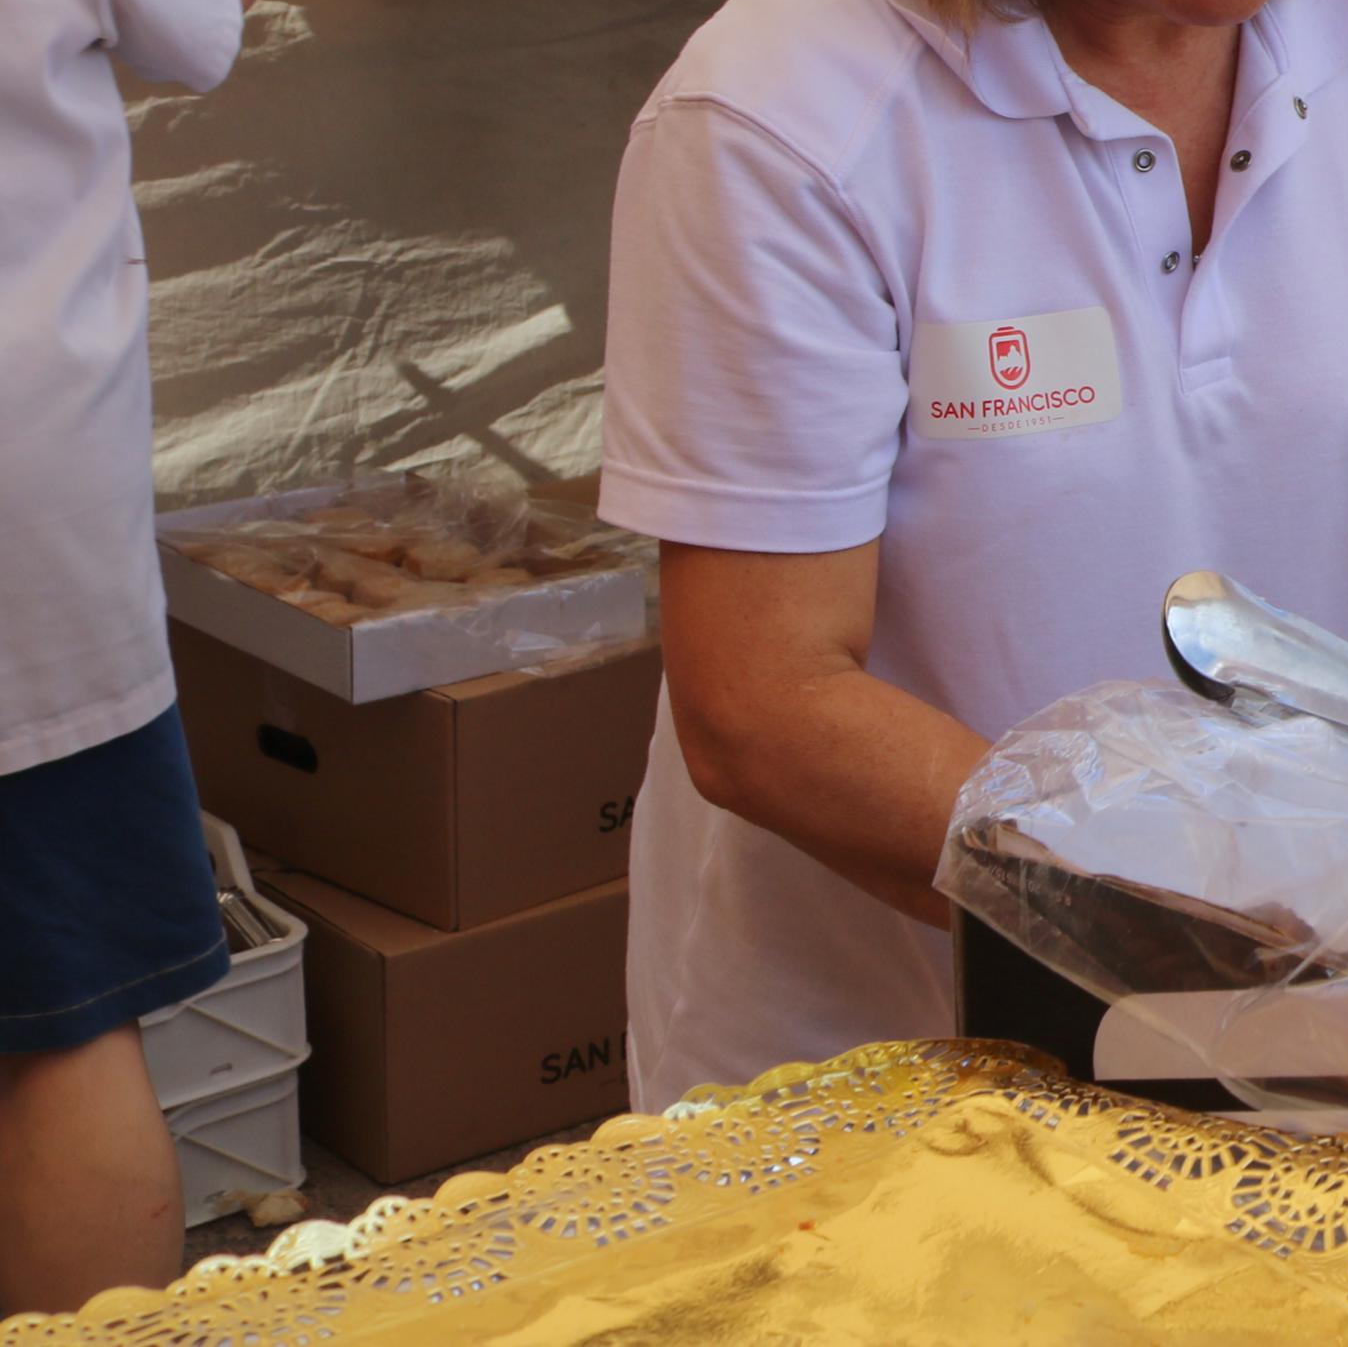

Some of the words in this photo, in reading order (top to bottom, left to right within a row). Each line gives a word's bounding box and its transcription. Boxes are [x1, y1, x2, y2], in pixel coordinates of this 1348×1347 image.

[931, 401, 975, 419] SAN
[981, 385, 1096, 418] FRANCISCO
[981, 419, 1022, 433] DESDE
[540, 1037, 610, 1085] SAN
